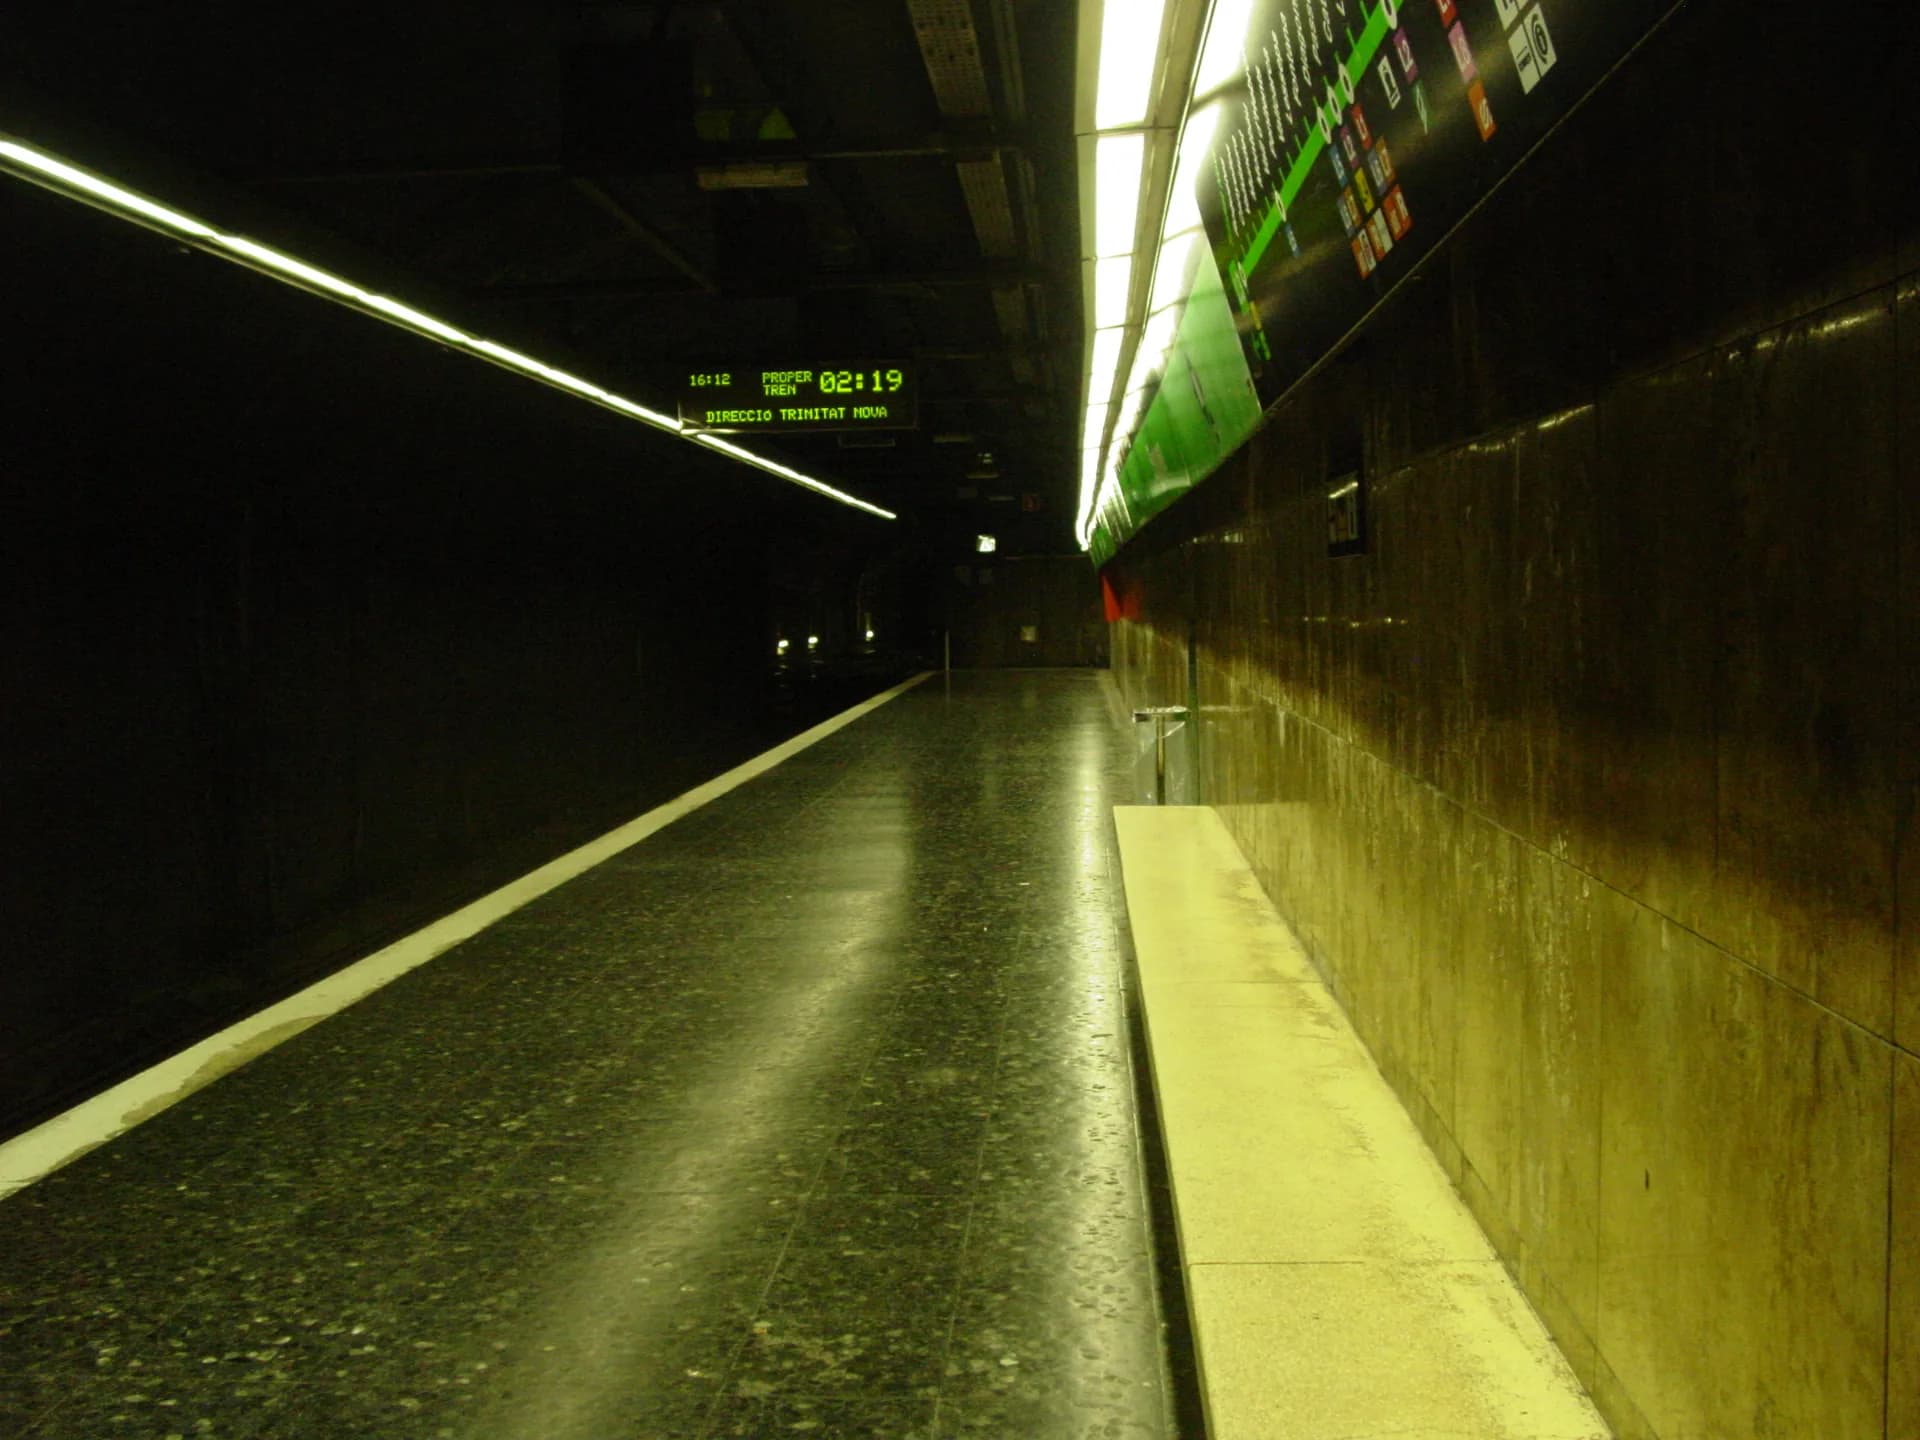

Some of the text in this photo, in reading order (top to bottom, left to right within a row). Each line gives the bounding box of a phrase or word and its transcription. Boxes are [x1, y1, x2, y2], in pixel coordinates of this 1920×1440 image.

[689, 373, 731, 387] 16:12
[762, 370, 812, 384] PROPER
[819, 369, 902, 393] 02:19
[763, 384, 797, 396] TREN
[779, 407, 846, 421] TRINITAT
[853, 406, 888, 419] NOVA
